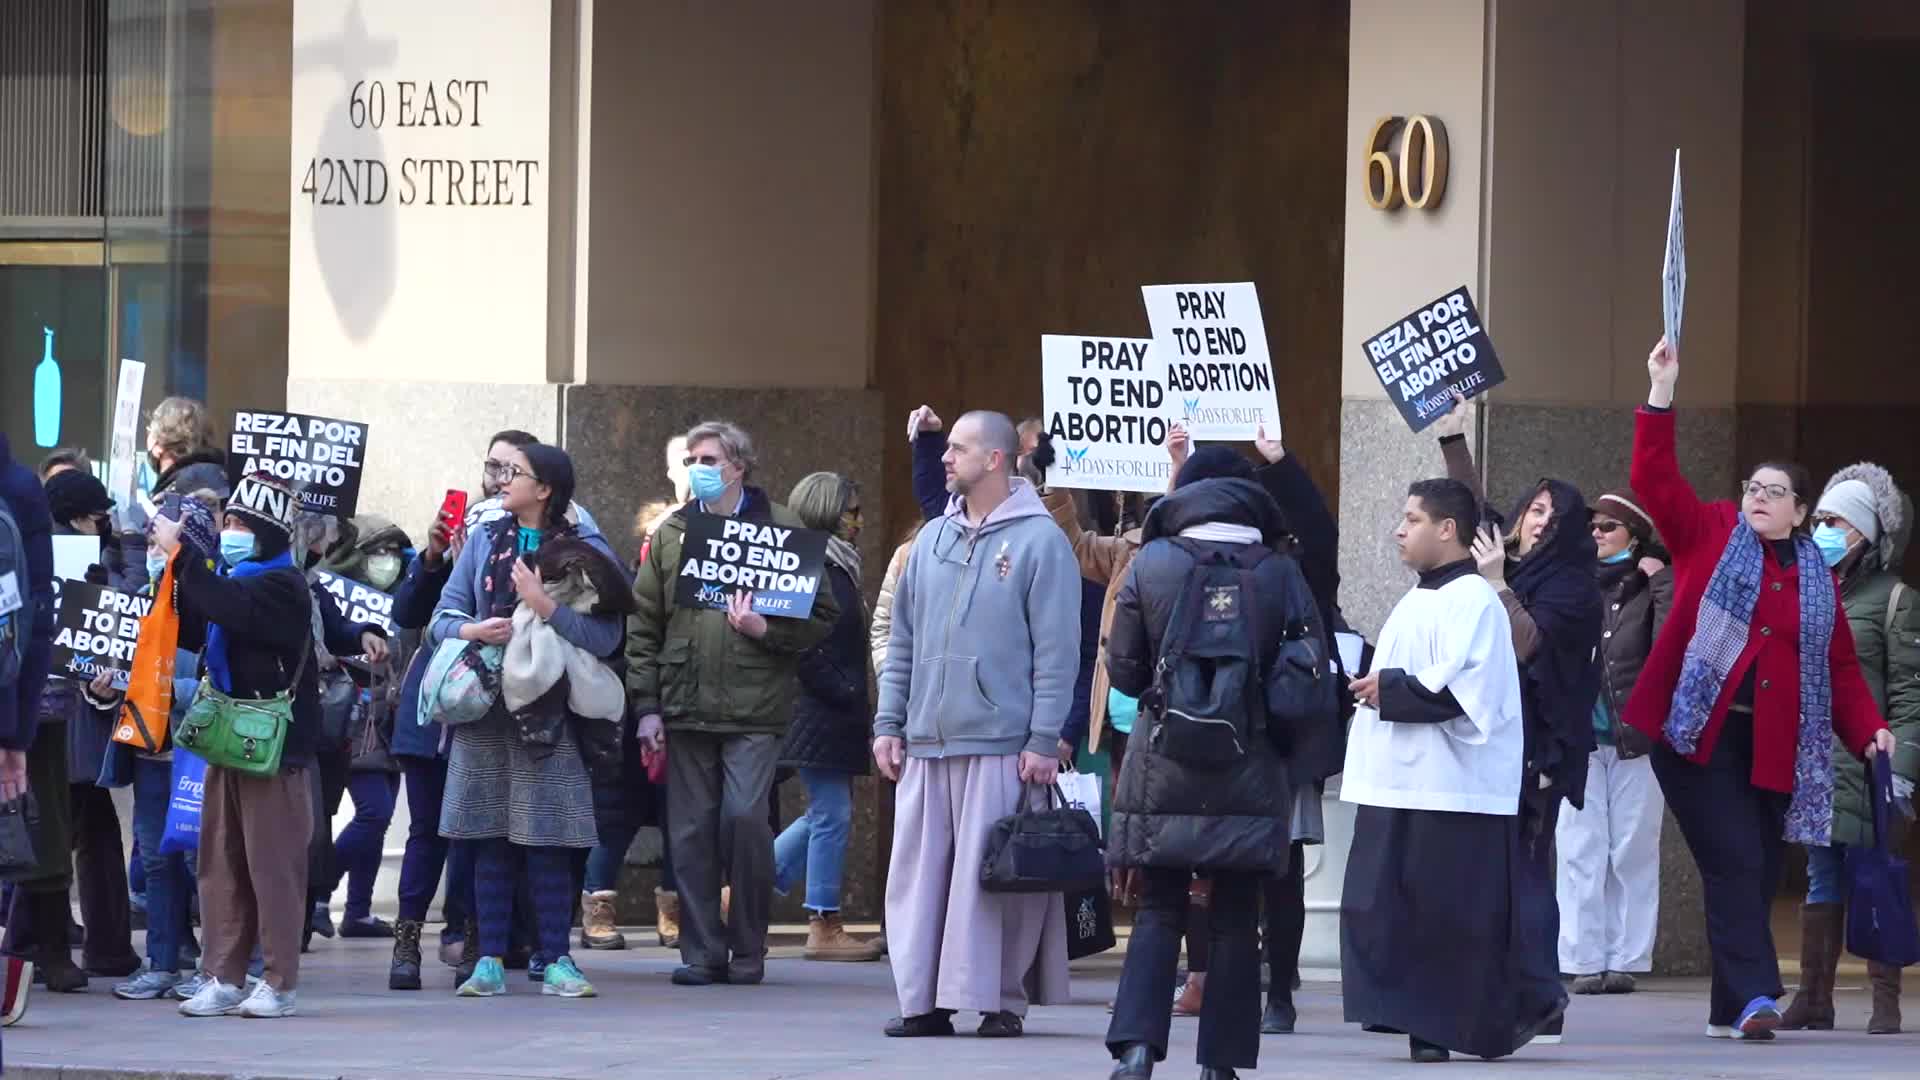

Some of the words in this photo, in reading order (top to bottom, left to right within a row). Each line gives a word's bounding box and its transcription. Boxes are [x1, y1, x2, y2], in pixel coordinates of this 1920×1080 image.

[350, 80, 385, 129] 60
[397, 79, 488, 127] EAST
[1363, 113, 1449, 209] 60
[301, 158, 388, 206] 42ND
[400, 158, 539, 206] STREET
[1176, 291, 1225, 319] PRAY
[1173, 327, 1201, 356] TO
[1204, 327, 1247, 356] END
[1368, 320, 1420, 363] REZA
[1418, 294, 1468, 332] POR
[1081, 340, 1149, 372] PRAY
[1376, 360, 1403, 385] EL
[1400, 338, 1434, 371] FIN
[1432, 316, 1480, 352] DEL
[1168, 363, 1270, 392] ABORTION
[1400, 343, 1476, 401] ABORTO
[1067, 376, 1102, 406] TO
[1110, 378, 1164, 409] END
[235, 412, 302, 437] REZA
[308, 419, 361, 445] POR
[231, 434, 260, 455] EL
[265, 436, 307, 459] FIN
[312, 442, 360, 468] DEL
[242, 457, 345, 487] ABORTO
[722, 519, 792, 547] PRAY
[706, 539, 741, 562] TO
[746, 546, 800, 571] END
[680, 558, 816, 594] ABORTION
[98, 590, 152, 616] PRAY
[82, 608, 114, 632] TO
[54, 627, 137, 661] ABORT
